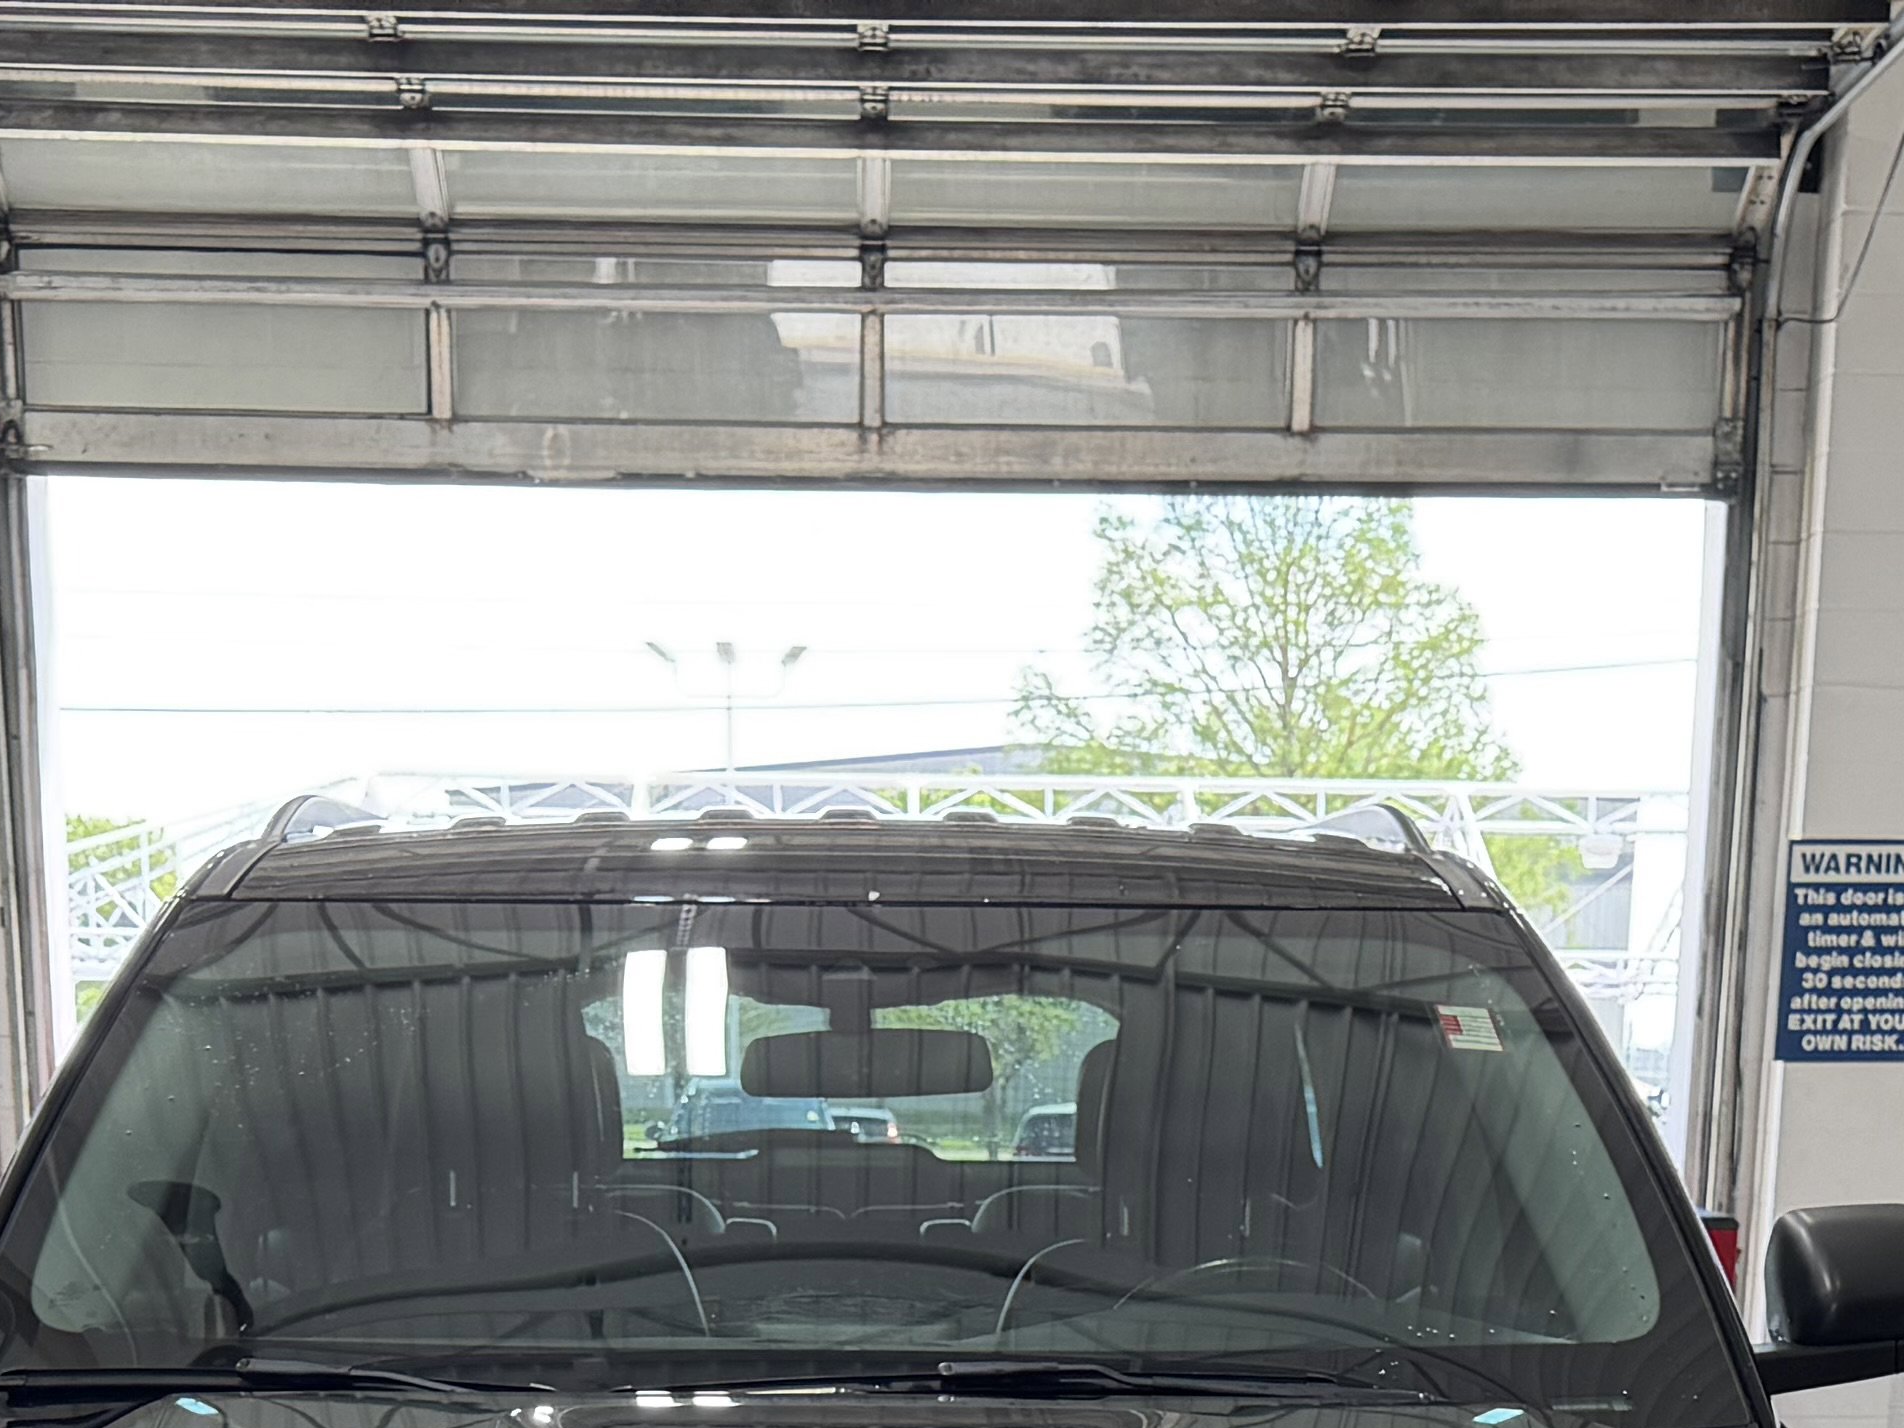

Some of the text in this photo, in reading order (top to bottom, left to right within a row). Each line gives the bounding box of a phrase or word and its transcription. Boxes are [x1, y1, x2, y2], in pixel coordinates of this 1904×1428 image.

[1794, 888, 1836, 906] This
[1840, 888, 1885, 906] door
[1887, 888, 1904, 906] is
[1798, 913, 1823, 927] an
[1807, 931, 1858, 948] timer
[1794, 951, 1850, 972] begin
[1801, 973, 1828, 989] 30
[1790, 993, 1839, 1010] after
[1787, 1014, 1835, 1031] EXIT
[1837, 1014, 1865, 1031] AT
[1801, 1035, 1848, 1052] OWN
